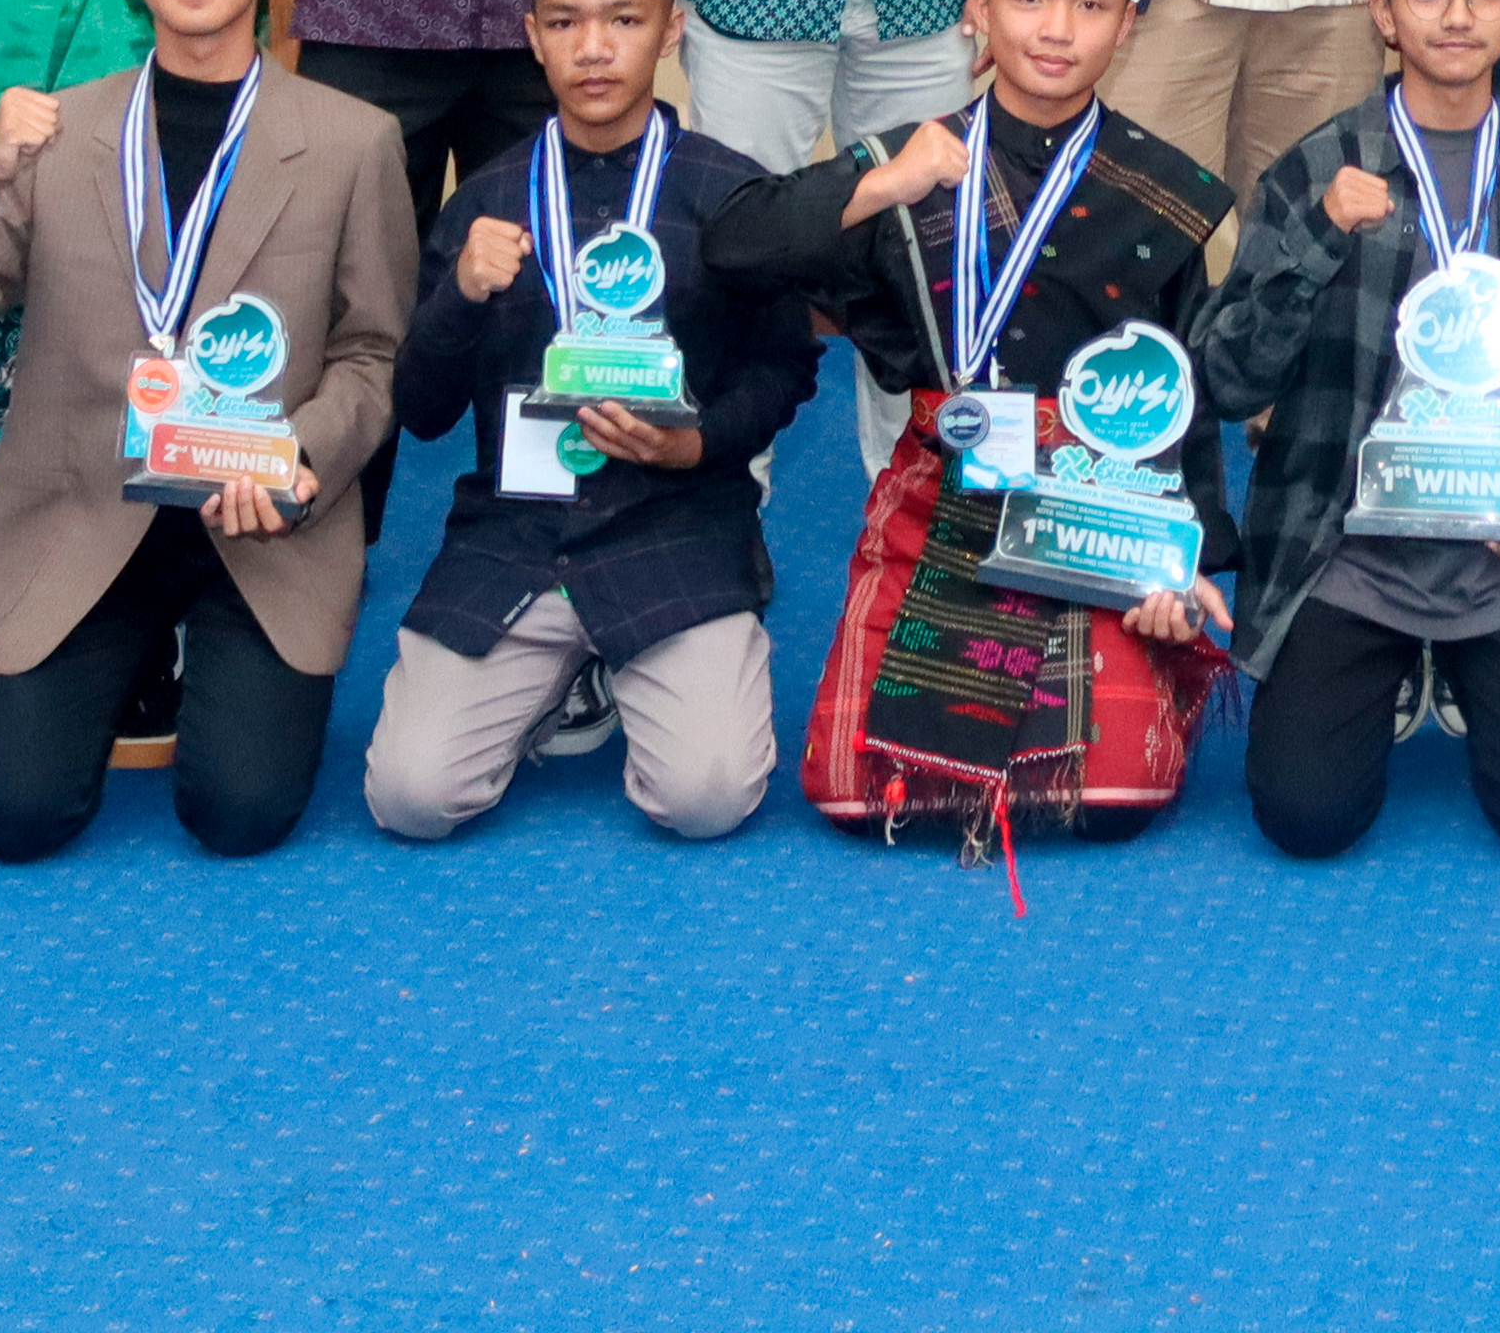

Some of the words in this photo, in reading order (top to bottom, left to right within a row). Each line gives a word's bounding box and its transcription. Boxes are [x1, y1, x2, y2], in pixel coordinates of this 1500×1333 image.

[581, 255, 654, 289] Oyisi
[194, 329, 276, 365] Oyisi
[585, 365, 672, 387] WINNER
[1072, 368, 1183, 416] Oyisi
[191, 446, 288, 476] WINNER
[1095, 467, 1181, 489] Excellent
[1380, 464, 1411, 492] 1st
[1023, 517, 1055, 544] 1st
[1056, 523, 1183, 569] WINNER
